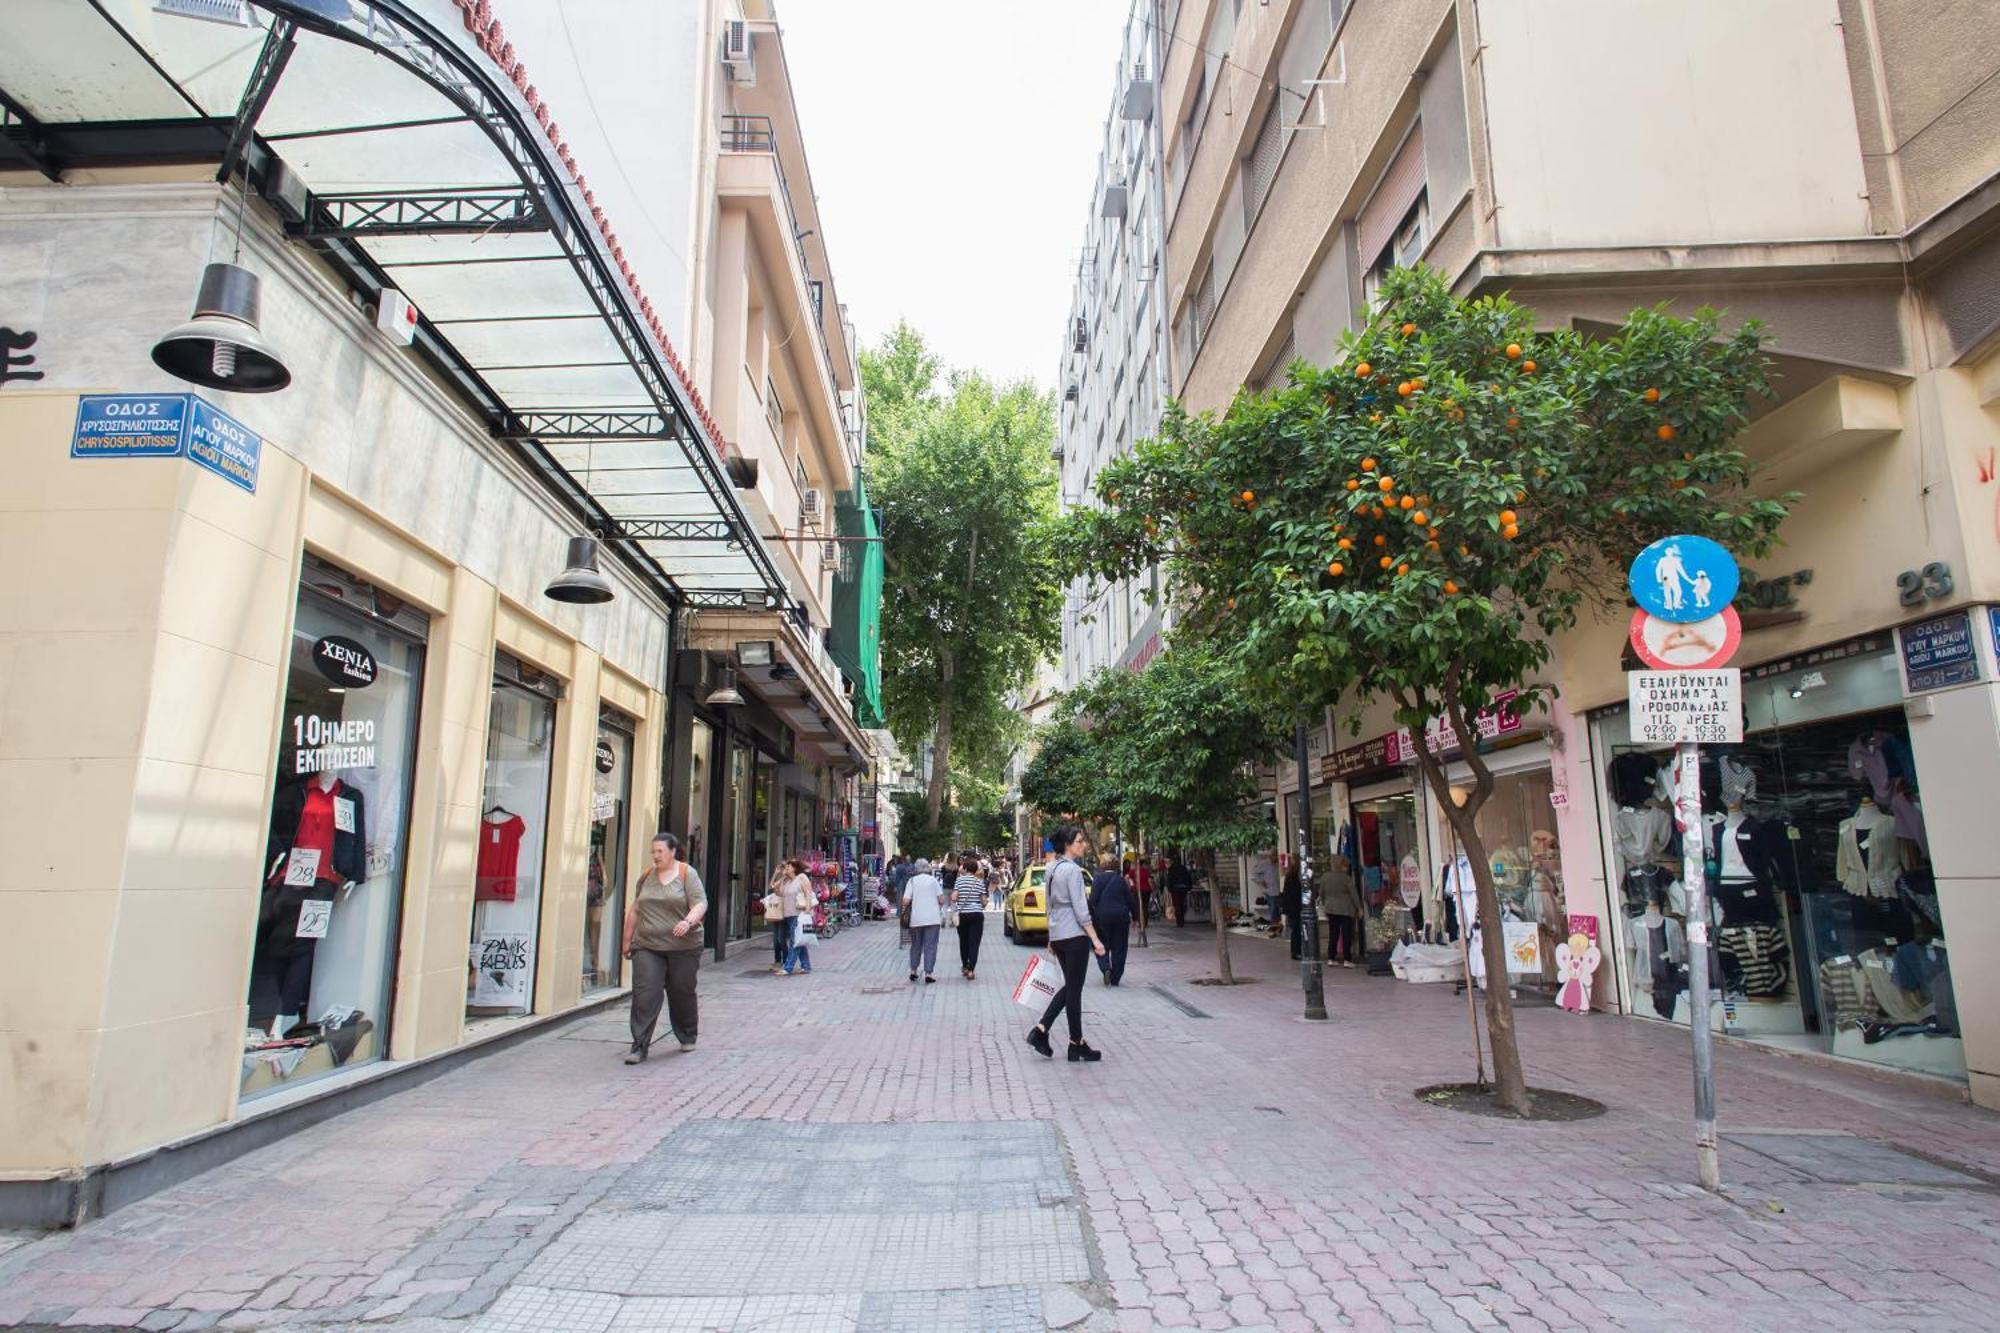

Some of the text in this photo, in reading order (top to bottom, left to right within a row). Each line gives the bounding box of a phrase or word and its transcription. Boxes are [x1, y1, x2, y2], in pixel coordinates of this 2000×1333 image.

[105, 403, 160, 416] ΟΔΟΣ
[212, 417, 246, 447] ΟΔΟΣ
[77, 435, 177, 449] CHRYSOSPILIOTISSIS
[194, 424, 256, 469] ΑΓΙΟΥ ΜΑΡΚΟΥ
[192, 441, 255, 484] AGIOU MARKOU
[1896, 561, 1955, 608] 23
[1915, 620, 1951, 637] ΟΔΟΣ
[1931, 630, 1965, 646] ΜΑΡΚΟΥ
[322, 640, 372, 672] XENIA
[1934, 643, 1969, 659] MARKOU
[343, 664, 372, 682] fashion
[1651, 714, 1673, 725] ΤΙΣ
[1643, 725, 1677, 733] 07:00
[1695, 725, 1727, 734] 10:30
[1646, 733, 1727, 742] 14:30 17:30
[295, 746, 375, 774] ΕΚΠΤΩΣΕΩΝ
[1552, 794, 1567, 804] 23
[292, 865, 314, 882] 28
[300, 911, 328, 932] 25
